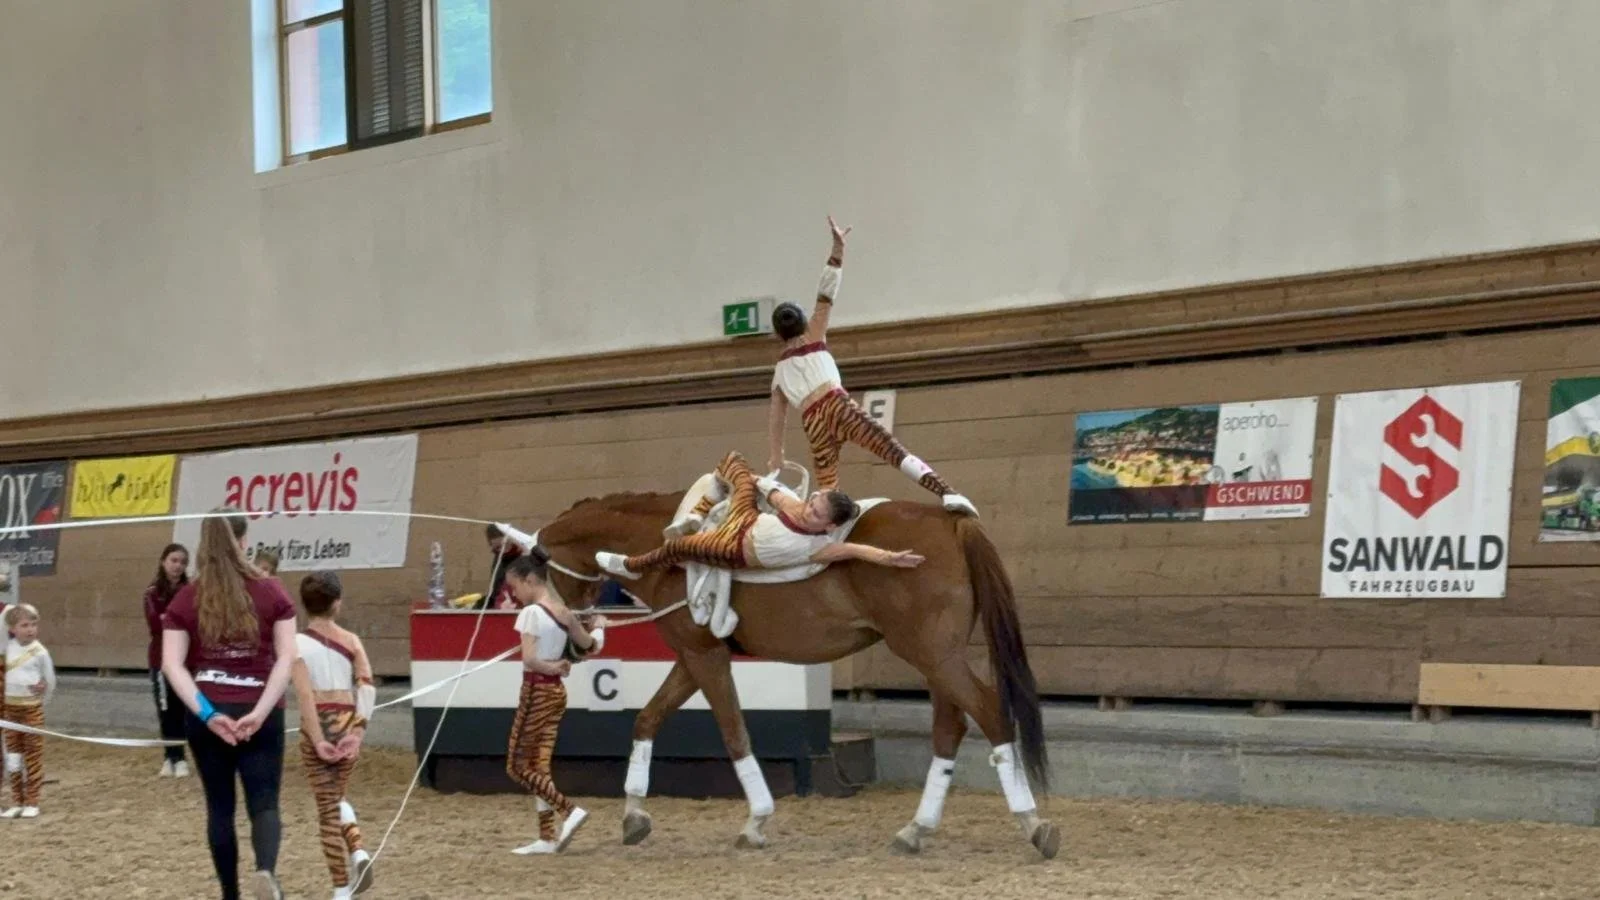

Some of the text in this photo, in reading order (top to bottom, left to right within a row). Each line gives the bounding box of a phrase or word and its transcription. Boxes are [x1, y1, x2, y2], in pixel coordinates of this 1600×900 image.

[225, 452, 359, 521] acrevis
[1216, 484, 1305, 508] GSCHWEND
[287, 539, 312, 560] fürs
[313, 538, 351, 560] Leben
[1328, 535, 1505, 573] SANWALD
[1349, 580, 1475, 593] FAHRZEUGBAU
[592, 668, 618, 701] C
